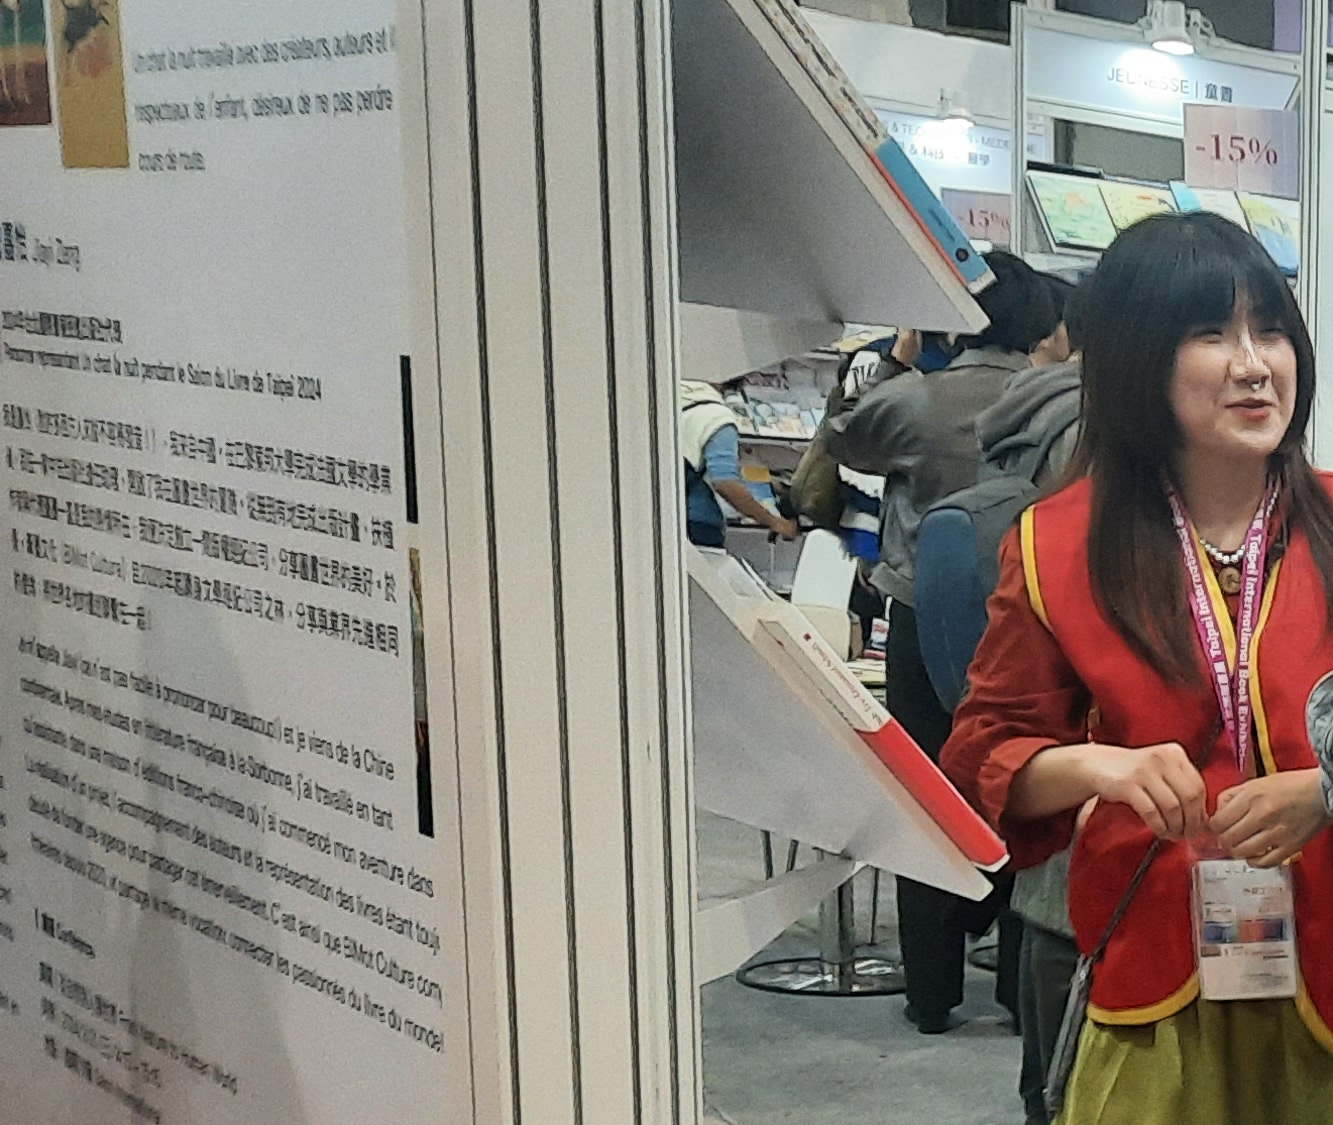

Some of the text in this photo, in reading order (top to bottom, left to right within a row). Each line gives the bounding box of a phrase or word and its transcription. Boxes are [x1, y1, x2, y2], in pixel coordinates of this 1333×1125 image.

[1194, 133, 1279, 168] -15%
[1248, 534, 1263, 575] Taipei
[1239, 576, 1258, 666] International
[363, 749, 394, 780] Chine
